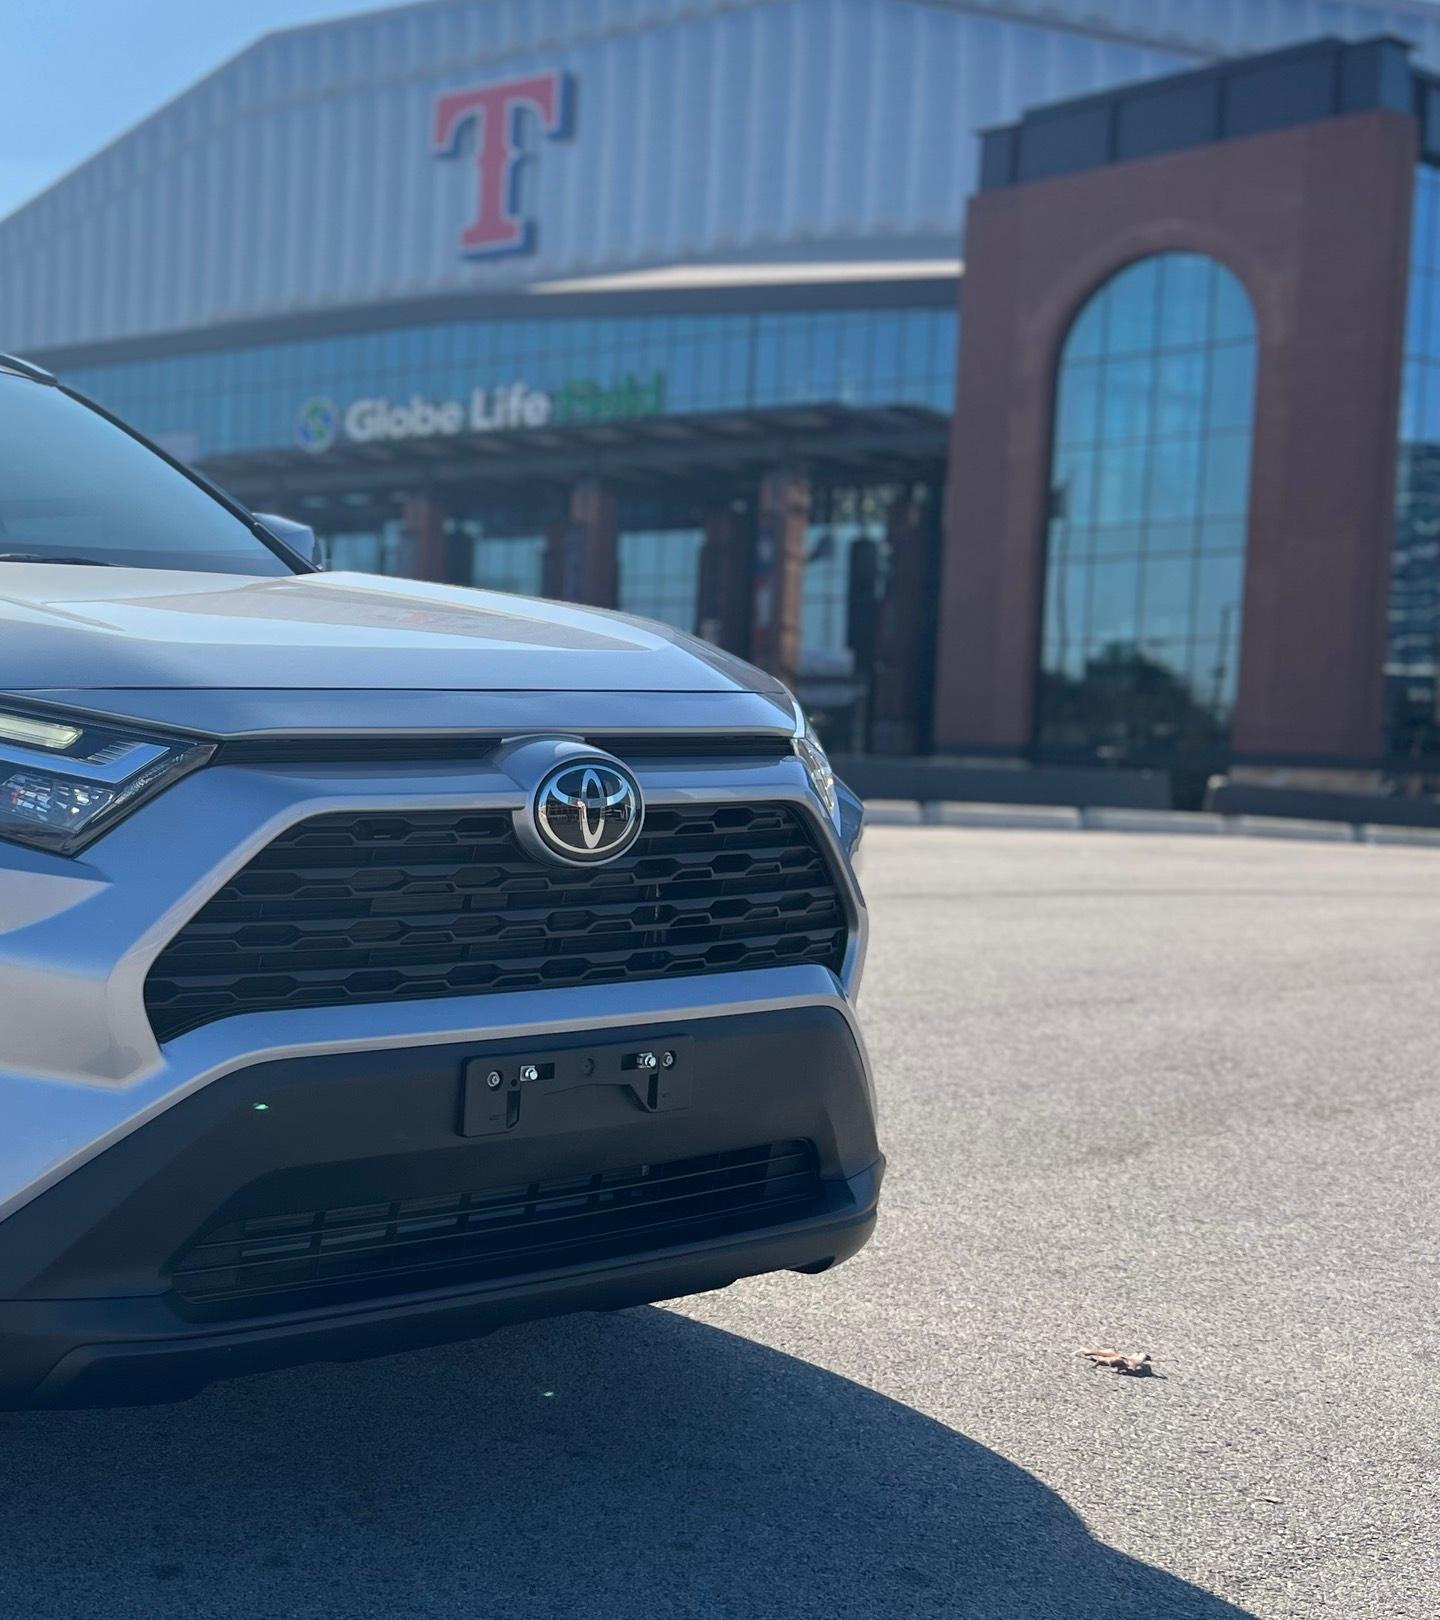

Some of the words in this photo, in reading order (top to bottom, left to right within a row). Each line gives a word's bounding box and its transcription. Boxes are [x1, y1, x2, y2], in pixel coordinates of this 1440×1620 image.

[430, 68, 576, 258] T
[345, 396, 463, 443] Globe
[470, 382, 552, 431] Life
